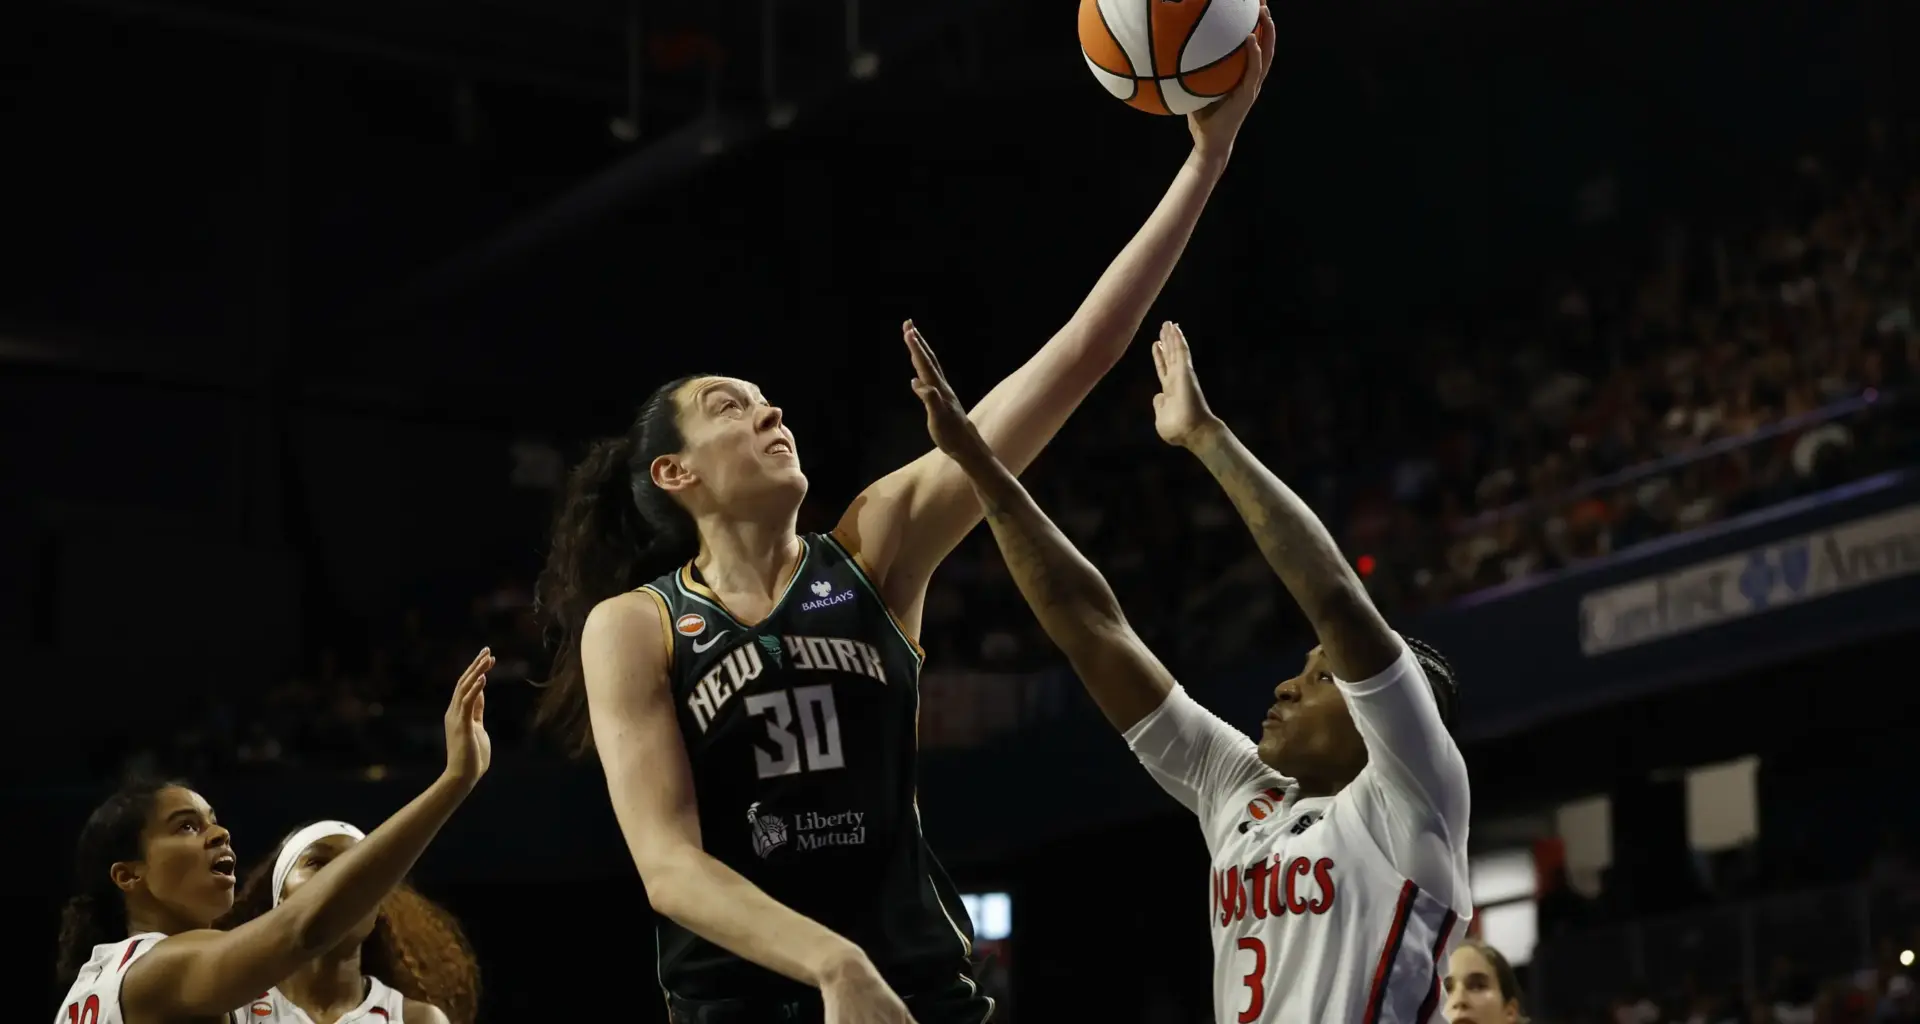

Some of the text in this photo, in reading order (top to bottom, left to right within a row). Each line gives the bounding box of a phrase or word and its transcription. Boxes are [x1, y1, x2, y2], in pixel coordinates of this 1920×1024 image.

[801, 589, 854, 611] BARCLAYS
[687, 634, 889, 735] NEW YORK
[743, 683, 847, 780] 30
[793, 808, 865, 831] Liberty
[796, 827, 866, 852] Mutual
[1237, 936, 1267, 1024] 3
